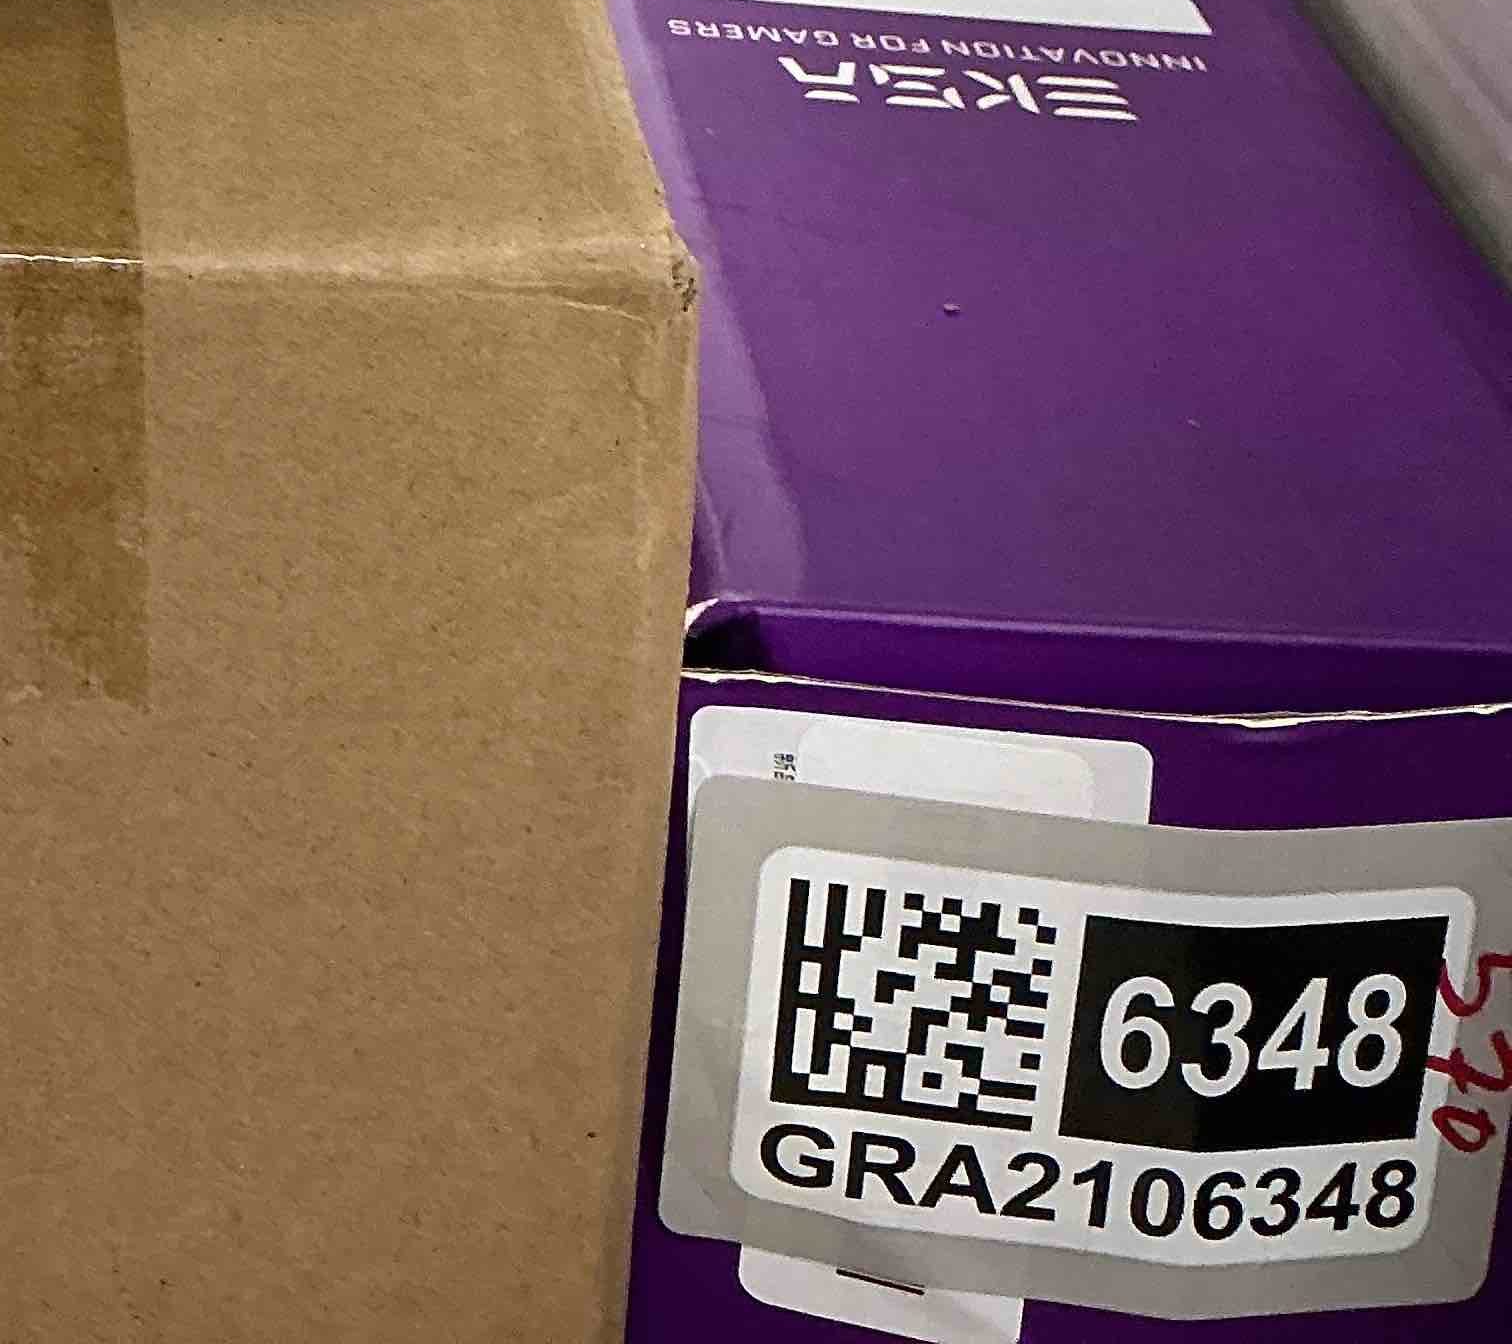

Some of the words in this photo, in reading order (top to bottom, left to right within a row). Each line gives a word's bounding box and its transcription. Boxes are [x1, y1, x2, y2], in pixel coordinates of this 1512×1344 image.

[667, 18, 840, 48] GAMERS
[850, 32, 930, 53] FOR
[941, 39, 1207, 73] INNOVATION
[777, 56, 1138, 121] EKSA
[1099, 973, 1407, 1098] 6348
[759, 1123, 1417, 1241] GRA2106348
